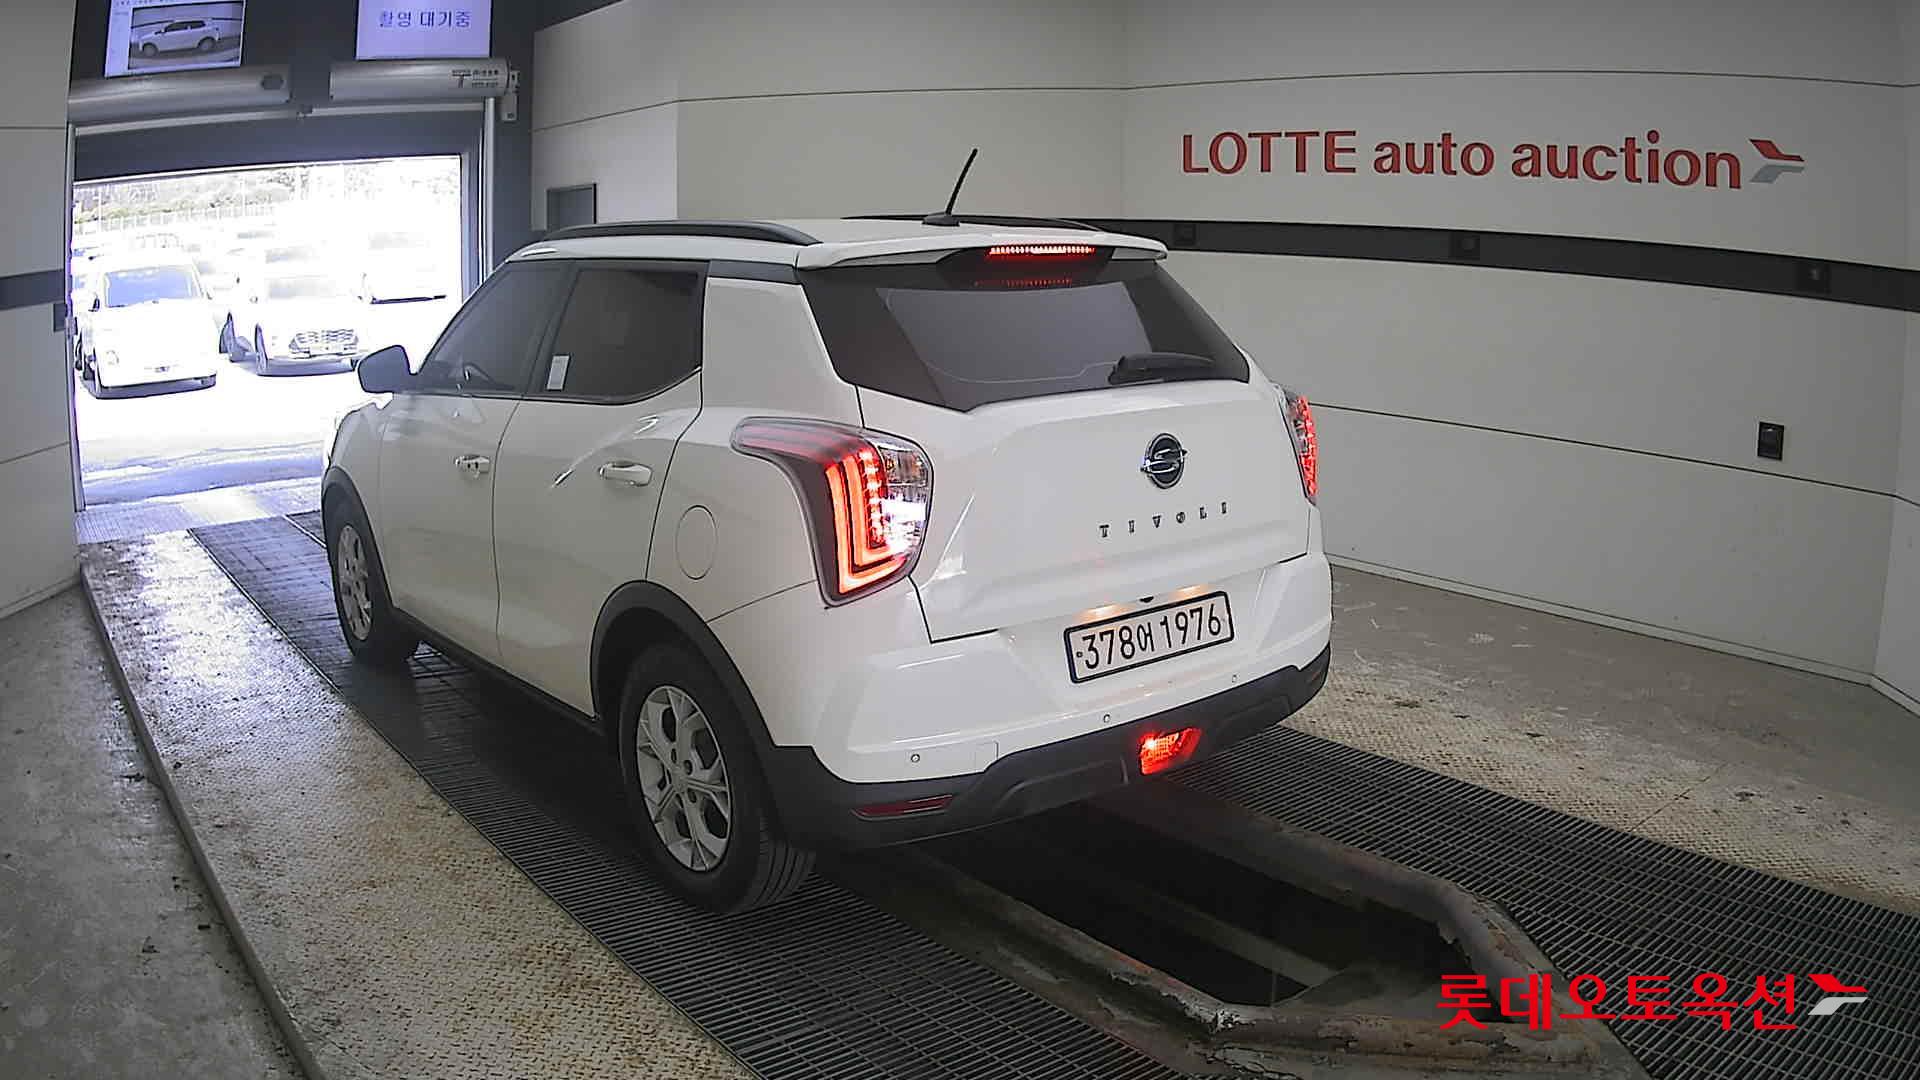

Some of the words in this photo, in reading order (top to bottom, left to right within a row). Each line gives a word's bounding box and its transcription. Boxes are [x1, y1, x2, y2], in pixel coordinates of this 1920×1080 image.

[419, 11, 470, 28] 대기중
[1182, 130, 1357, 174] LOTTE
[1374, 132, 1495, 177] auto
[1511, 129, 1743, 190] auction
[1098, 501, 1228, 539] TIVOLI
